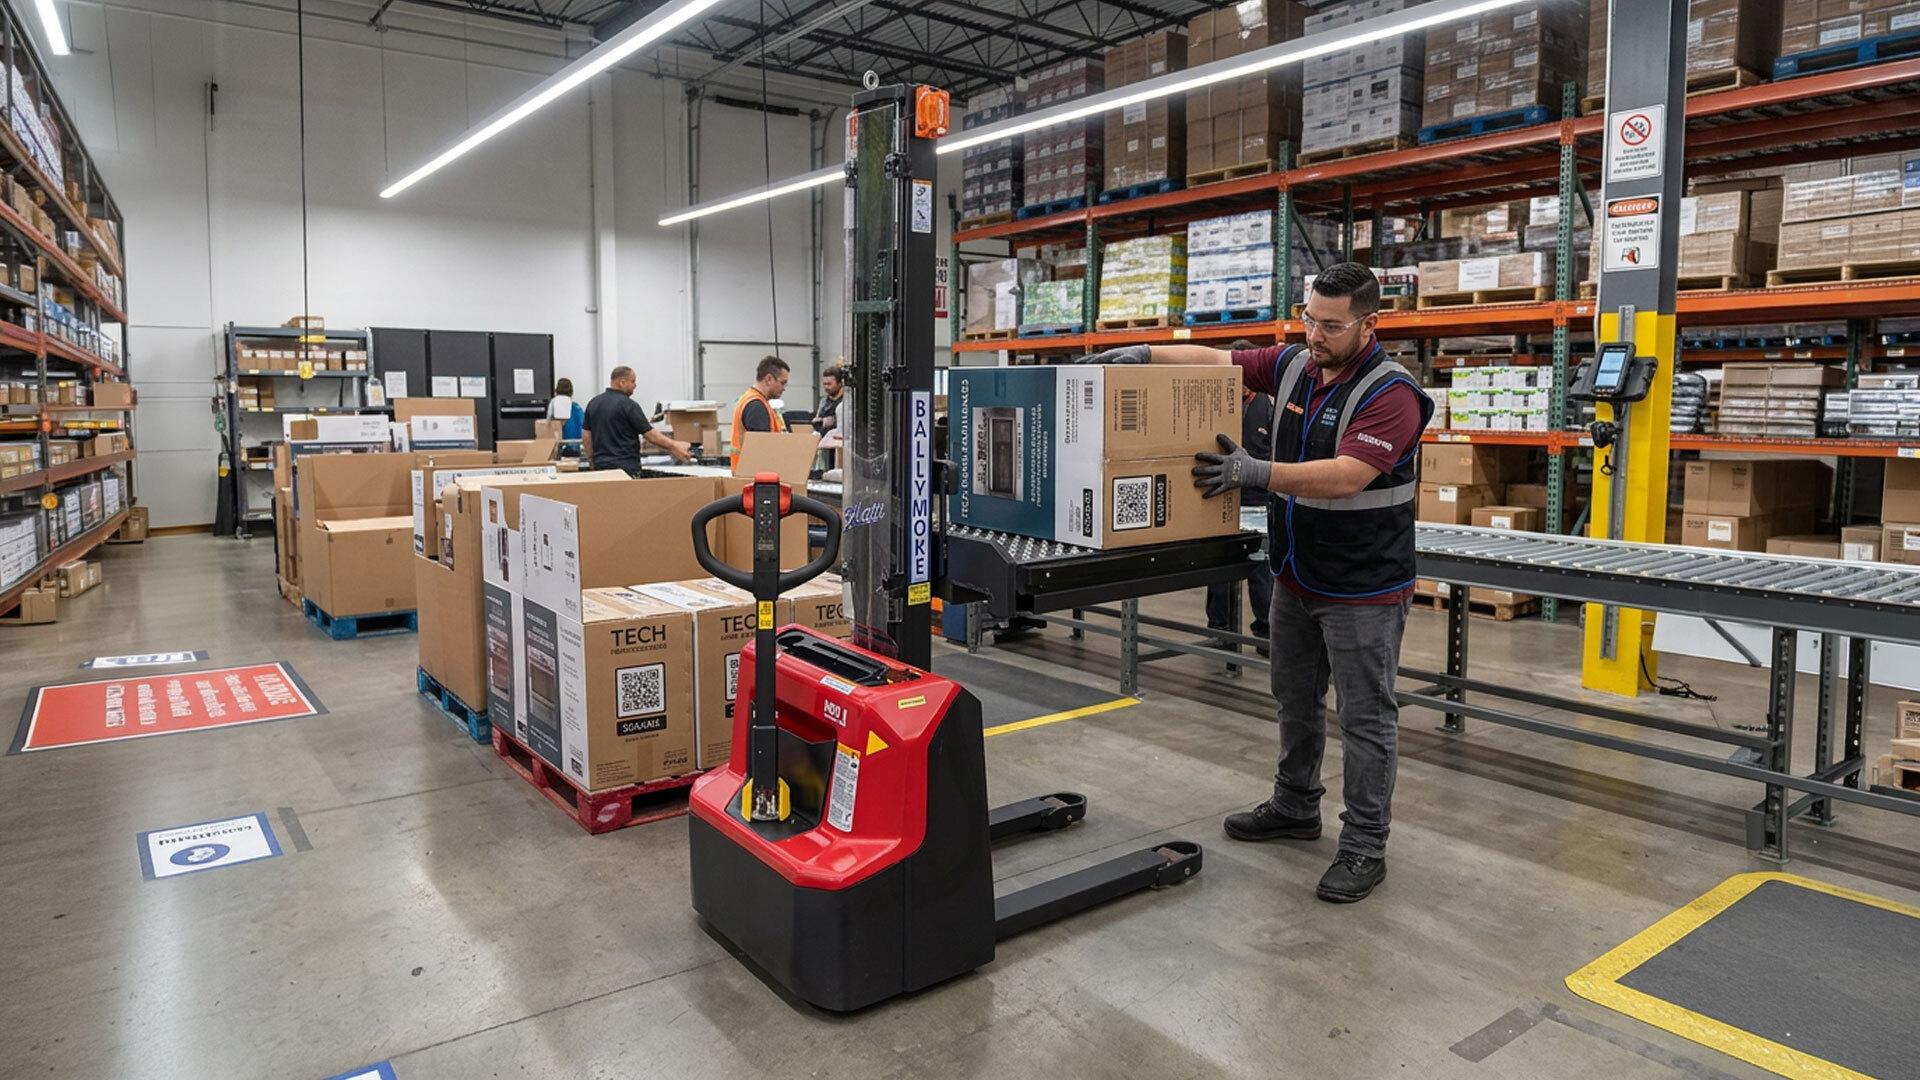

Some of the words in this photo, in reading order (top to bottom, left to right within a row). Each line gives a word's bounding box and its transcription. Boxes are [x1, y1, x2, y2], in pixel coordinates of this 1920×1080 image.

[913, 400, 928, 575] BALLYMOKE
[816, 603, 843, 621] TEC
[720, 613, 756, 633] TEC
[610, 624, 666, 647] TECH
